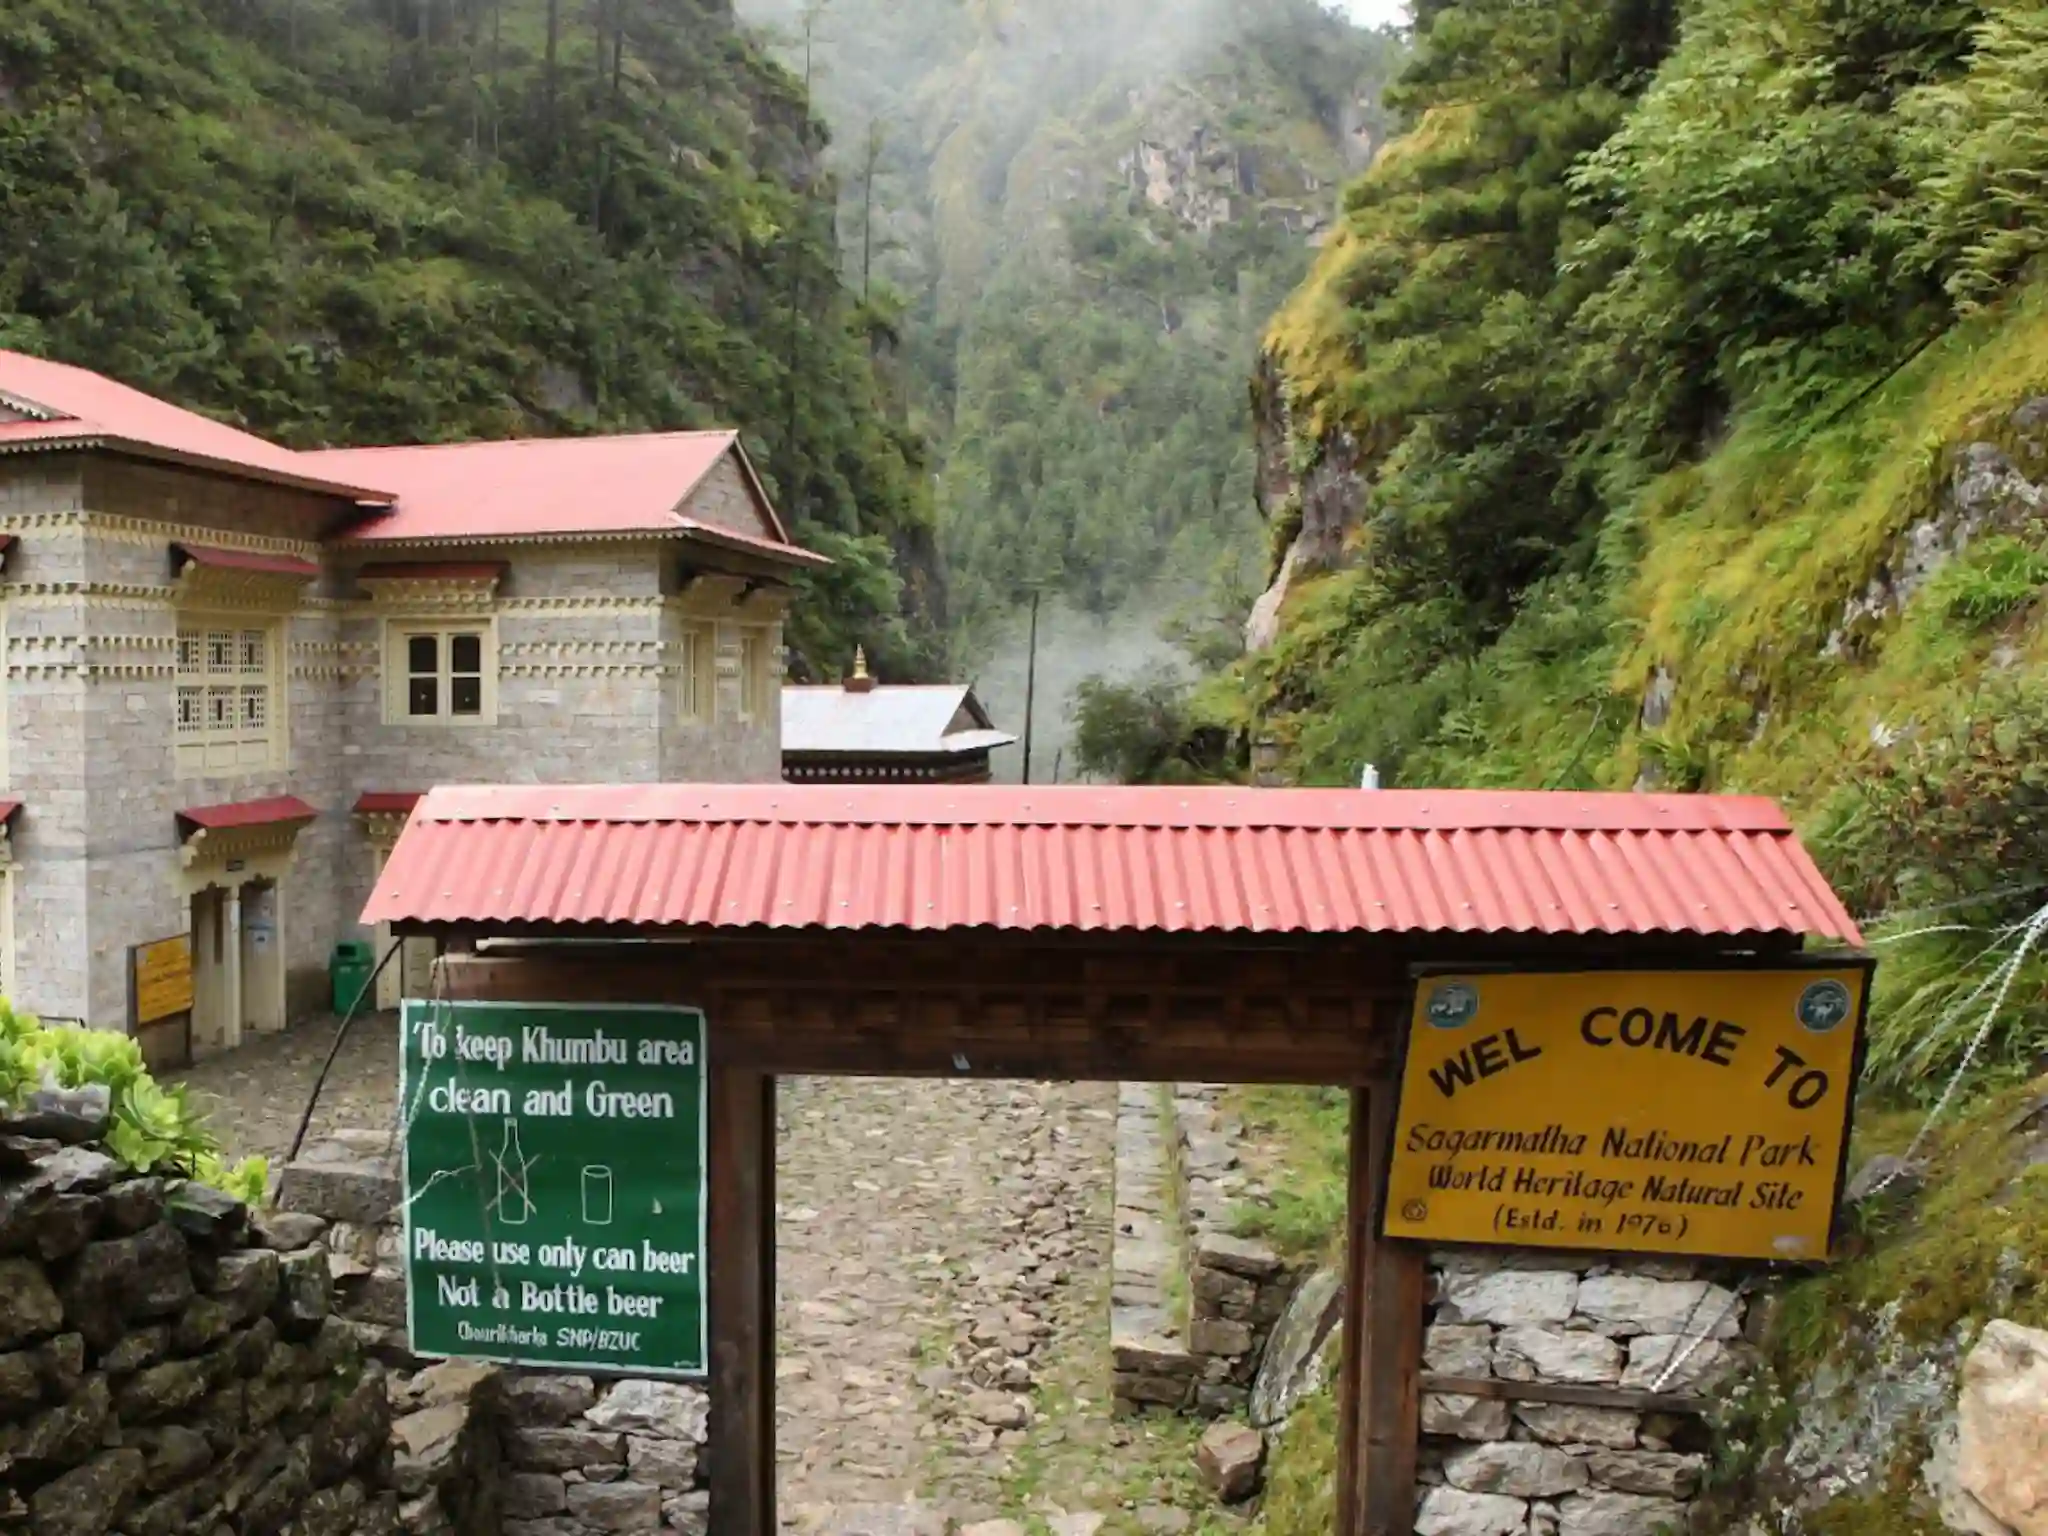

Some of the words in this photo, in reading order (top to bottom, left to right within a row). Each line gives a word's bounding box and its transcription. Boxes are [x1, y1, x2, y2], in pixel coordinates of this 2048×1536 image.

[456, 1024, 513, 1071] keep
[522, 1025, 628, 1064] Khumbu
[637, 1038, 694, 1066] area
[1428, 1027, 1542, 1098] WEL
[1580, 1006, 1746, 1067] COME
[1762, 1044, 1829, 1109] TO
[429, 1076, 511, 1114] clean
[523, 1079, 573, 1117] and
[586, 1079, 675, 1118] Green
[1406, 1123, 1588, 1161] Sagarmatha
[1601, 1127, 1732, 1164] National
[1739, 1134, 1820, 1167] Park
[1429, 1165, 1507, 1193] World
[1513, 1166, 1634, 1208] Heritage
[1641, 1175, 1744, 1208] Natural
[1748, 1180, 1804, 1210] Site
[1576, 1212, 1603, 1233] in
[414, 1227, 484, 1263] Please
[492, 1238, 530, 1266] use
[538, 1236, 588, 1278] only
[592, 1247, 636, 1272] can
[643, 1239, 696, 1275] beer
[437, 1275, 481, 1308] Not
[491, 1284, 510, 1309] a
[520, 1280, 599, 1315] Bottle
[607, 1286, 664, 1318] beer
